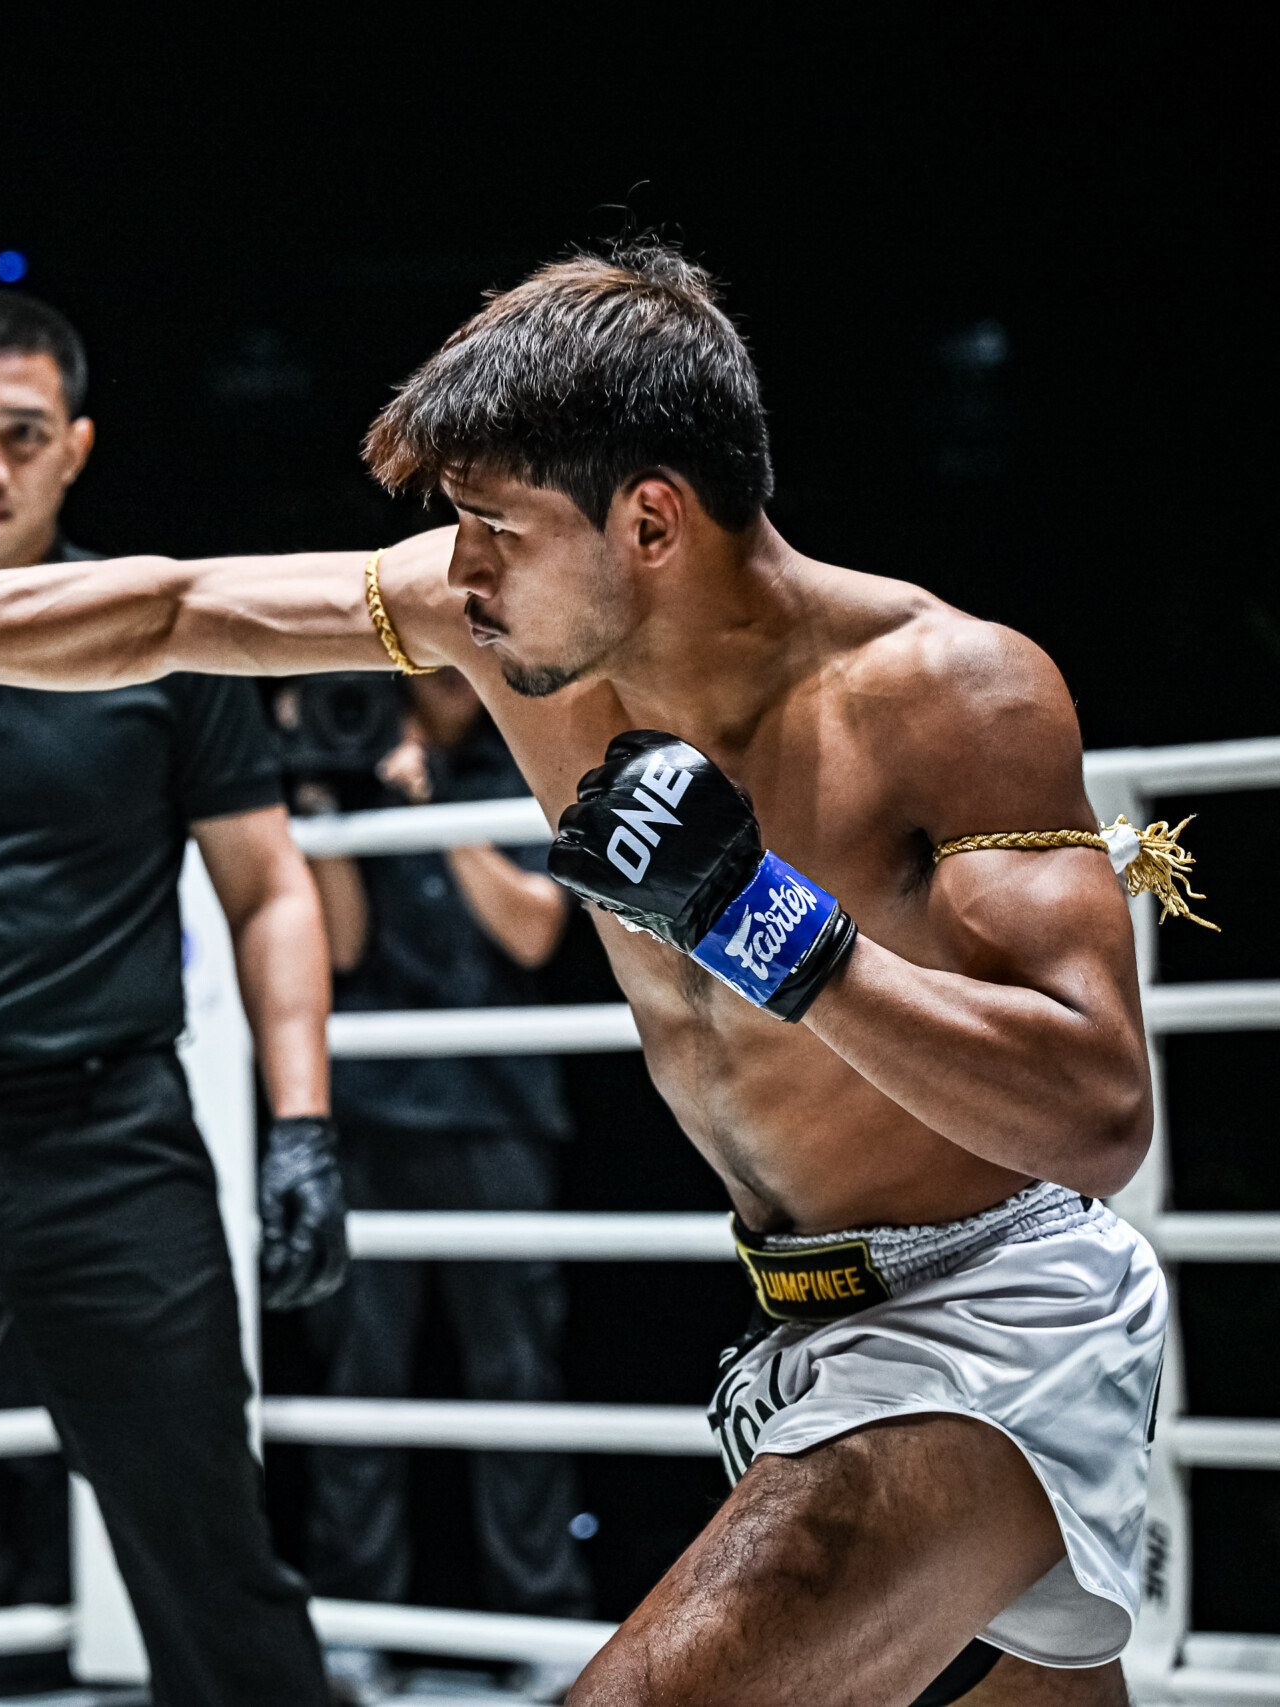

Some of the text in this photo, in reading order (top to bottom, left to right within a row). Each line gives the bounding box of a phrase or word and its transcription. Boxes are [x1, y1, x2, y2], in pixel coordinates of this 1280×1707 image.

[606, 752, 694, 884] ONE
[724, 875, 817, 981] Fairtex
[761, 1266, 866, 1303] LUMPINEE
